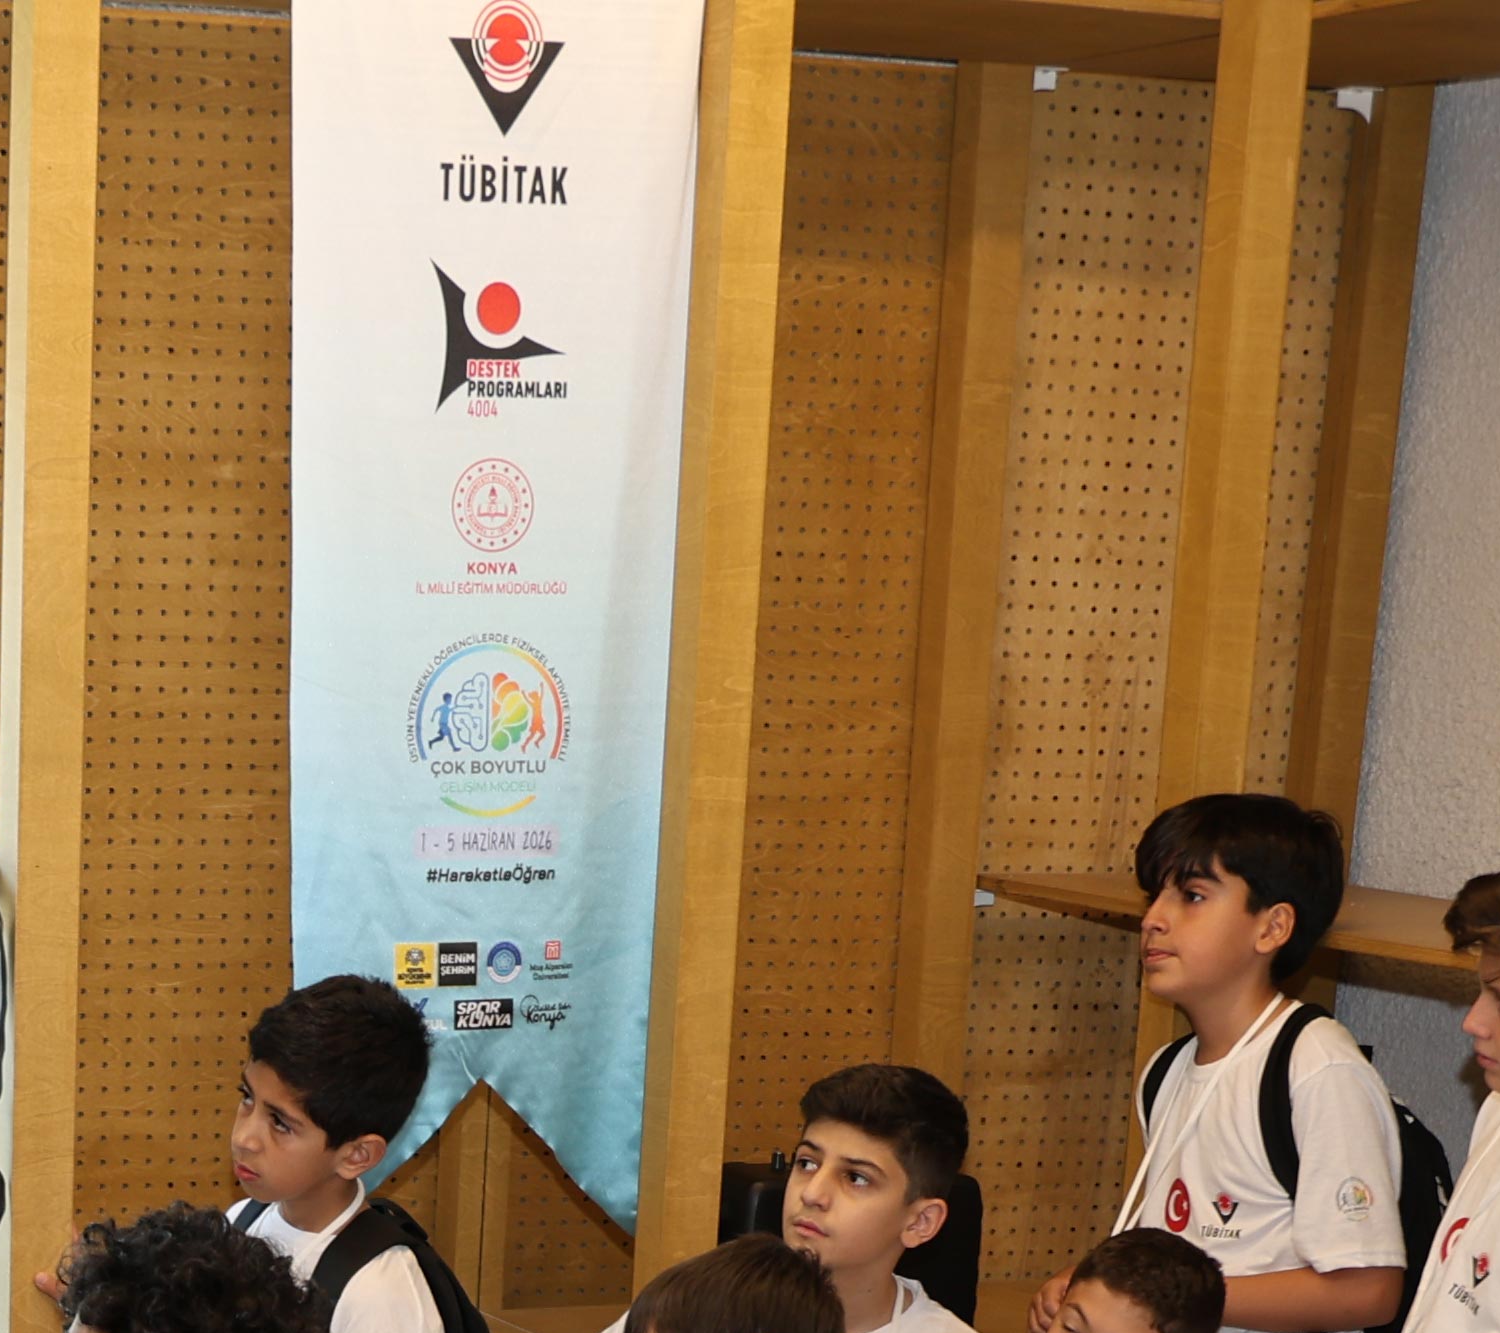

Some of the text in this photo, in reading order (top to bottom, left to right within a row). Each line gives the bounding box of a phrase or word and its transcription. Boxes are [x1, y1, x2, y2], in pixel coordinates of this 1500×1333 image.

[440, 154, 568, 205] TÜBİTAK
[467, 360, 520, 378] DESTEK
[467, 380, 568, 399] PROGRAMLARI
[466, 400, 499, 418] 4004
[466, 562, 518, 575] KONYA
[457, 580, 494, 595] EĞİTİM
[496, 580, 568, 595] MÜDÜRLÜĞÜ
[430, 760, 546, 778] ÇOK BOYUTLU
[446, 832, 455, 852] 5
[462, 828, 516, 852] HAZİRAN
[522, 830, 553, 851] 2026
[456, 1001, 501, 1018] SPOR
[1200, 1225, 1242, 1240] TÜBİTAK
